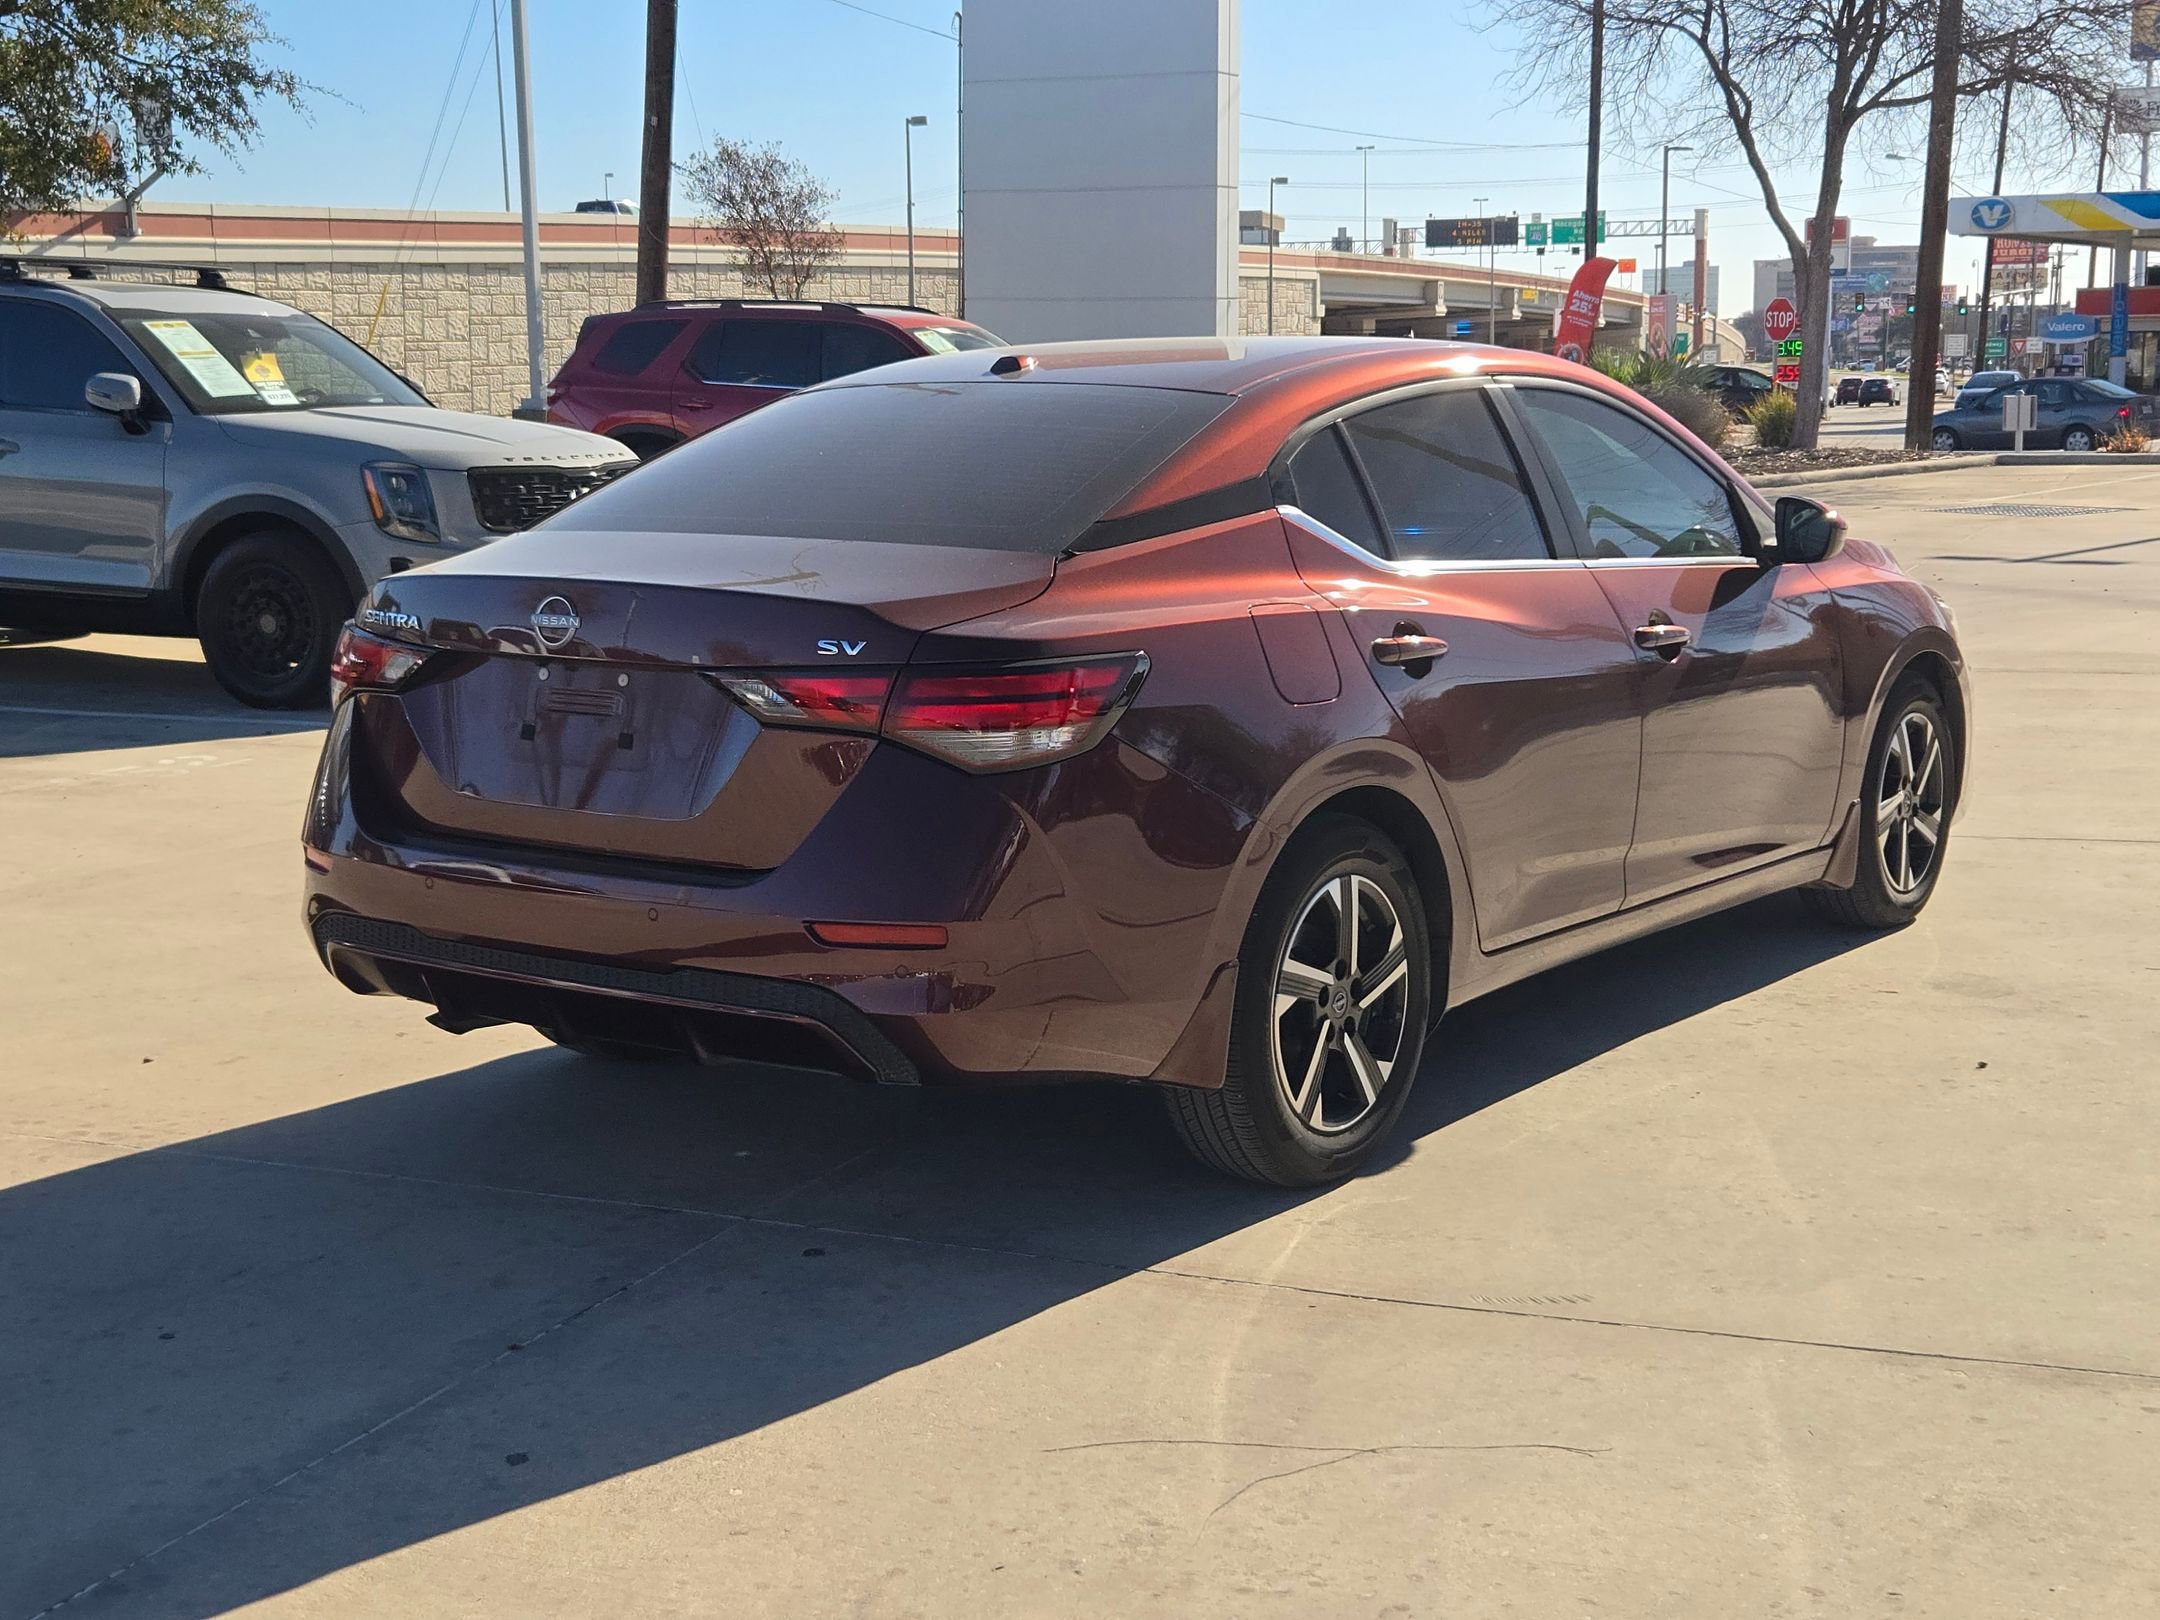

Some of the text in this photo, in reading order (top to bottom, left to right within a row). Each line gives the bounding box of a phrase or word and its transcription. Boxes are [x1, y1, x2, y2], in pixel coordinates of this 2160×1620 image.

[1573, 289, 1600, 304] Ahorra
[1766, 311, 1793, 328] STOP
[2047, 322, 2086, 332] Valero
[2112, 300, 2125, 354] Valero
[365, 609, 420, 630] SENTRA
[531, 615, 580, 627] NISSAN
[817, 639, 868, 656] SV
